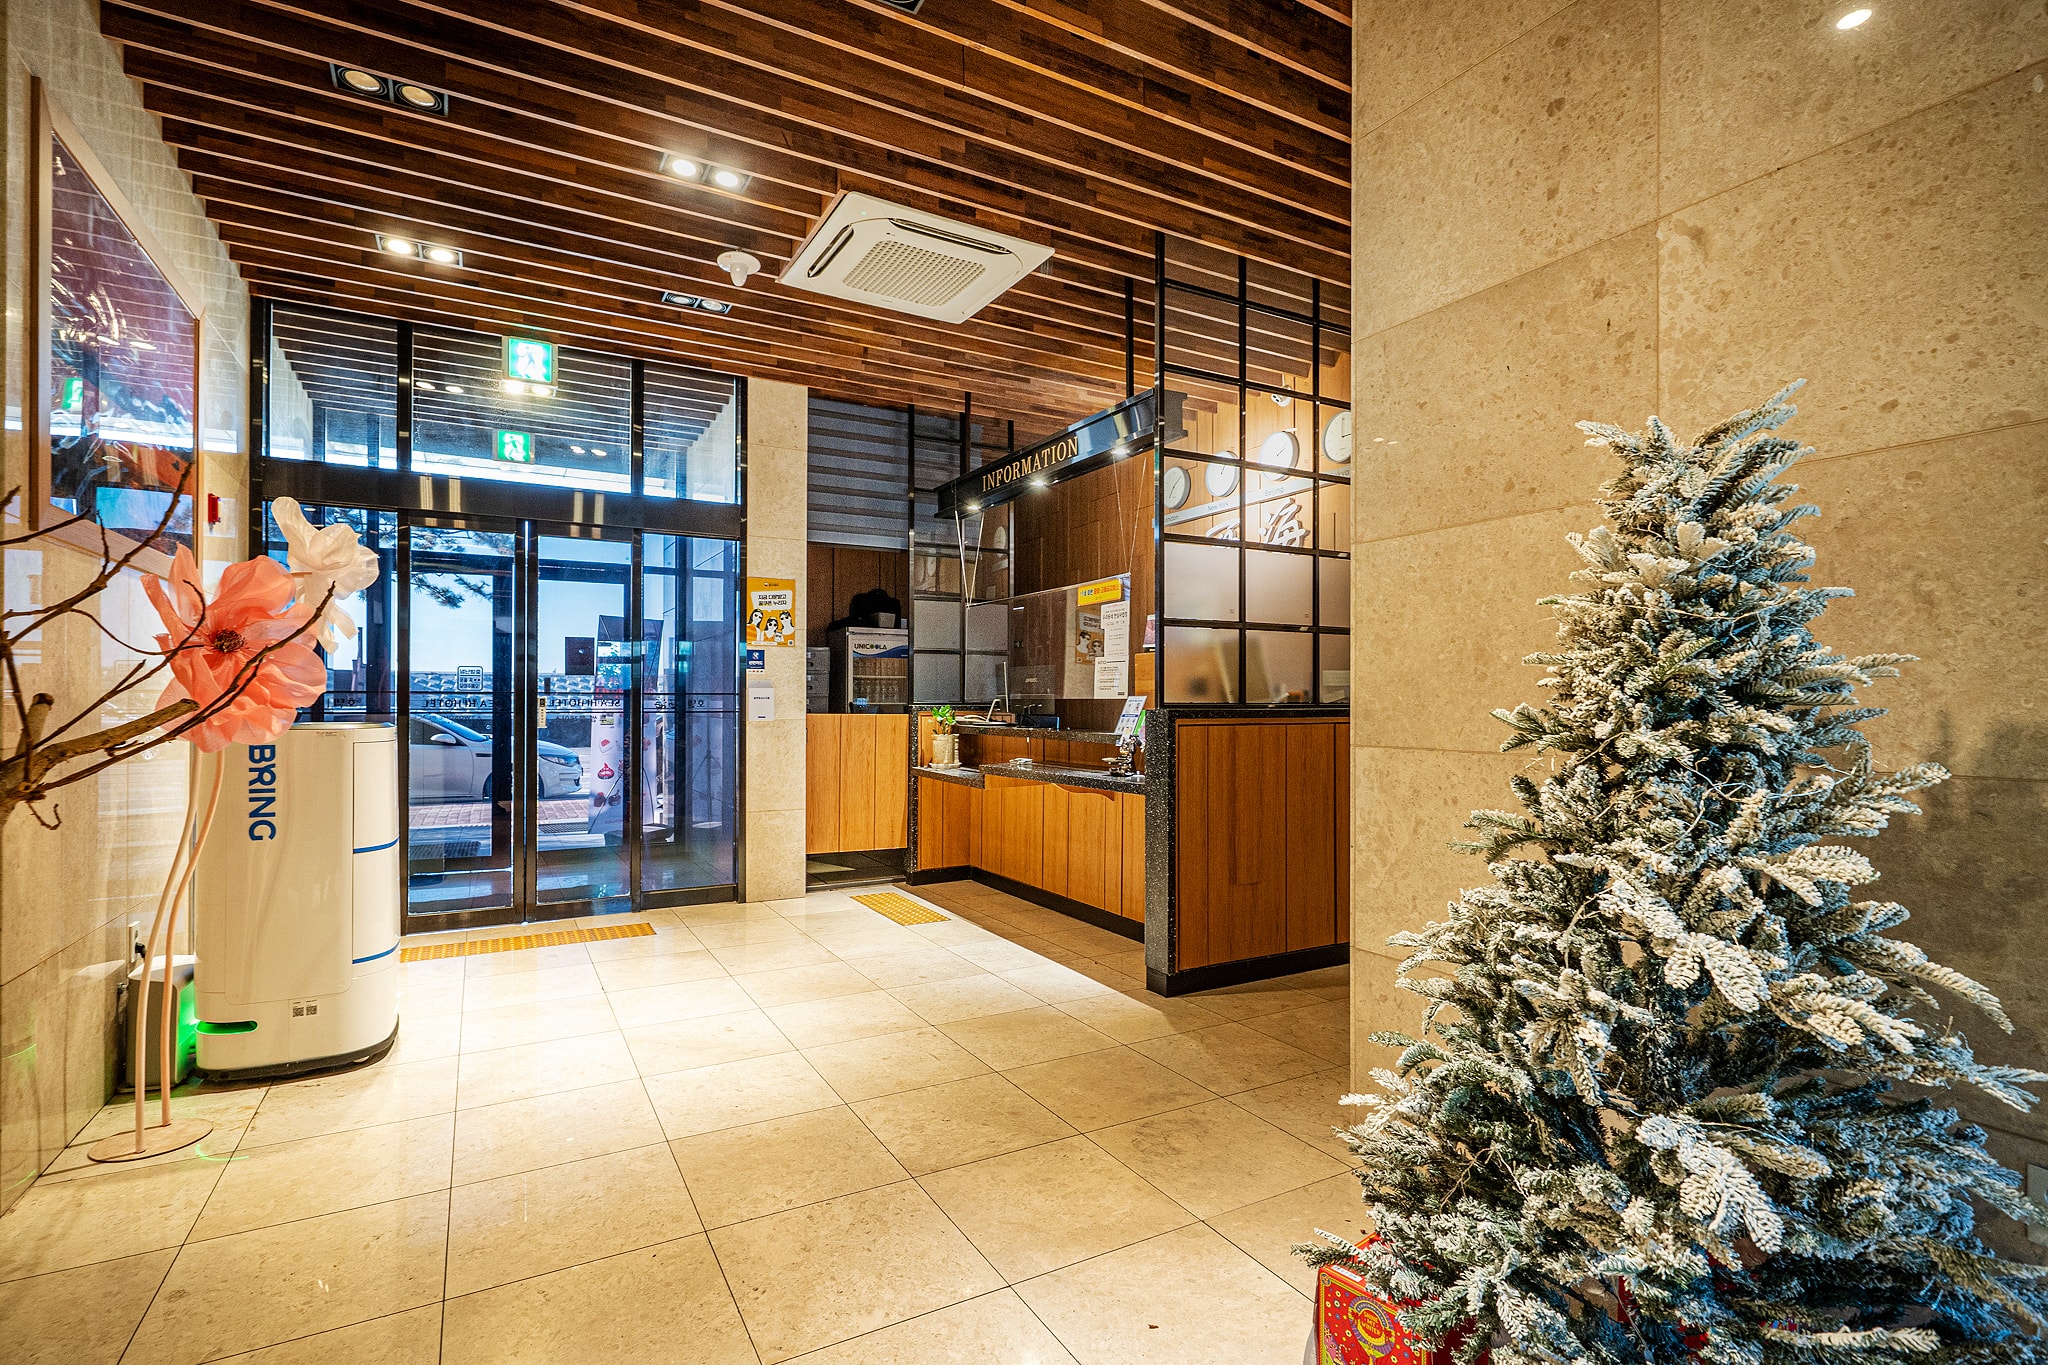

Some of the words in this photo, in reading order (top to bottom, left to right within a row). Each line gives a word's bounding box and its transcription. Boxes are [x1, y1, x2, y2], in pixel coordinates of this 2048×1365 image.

[982, 436, 1079, 492] INFORMATION
[1265, 487, 1284, 497] Beijing
[1207, 504, 1218, 512] New
[248, 745, 277, 841] BRING
[1361, 1321, 1381, 1335] WINTER
